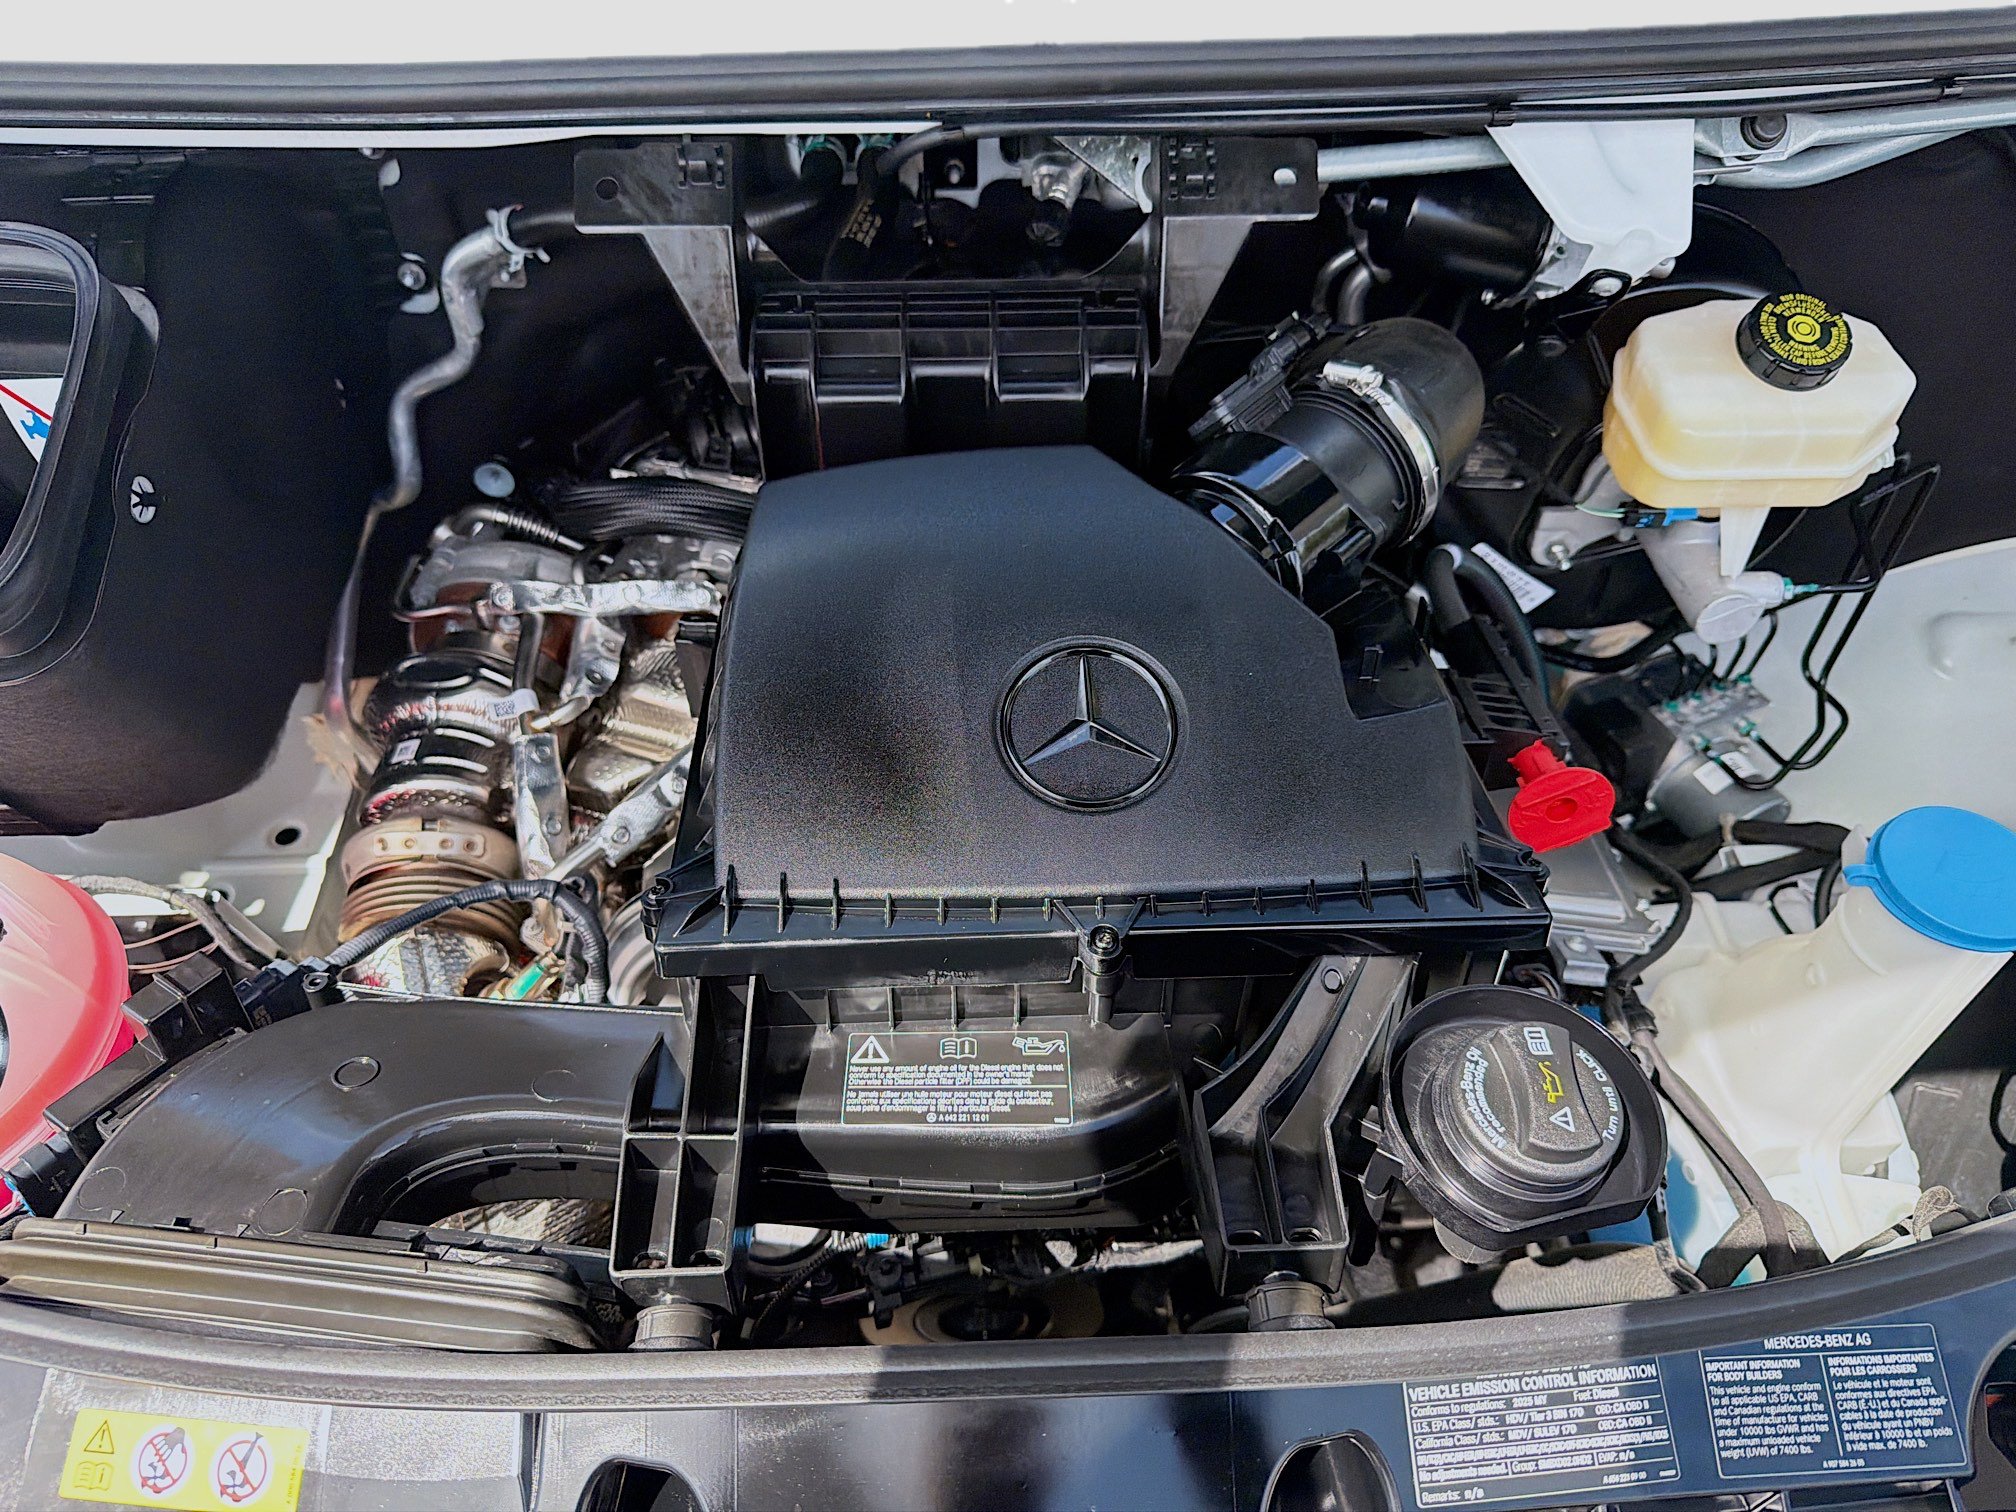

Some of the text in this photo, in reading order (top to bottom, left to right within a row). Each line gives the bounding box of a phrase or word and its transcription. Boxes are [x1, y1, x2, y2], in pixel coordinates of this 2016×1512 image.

[1576, 1049, 1607, 1082] CLICK
[1460, 1046, 1507, 1149] Mercedes-Benz Oil
[1474, 1058, 1506, 1133] recommended
[1602, 1086, 1619, 1140] Turn until
[1764, 1333, 1871, 1350] MERCEDES-BENZ AG
[1705, 1359, 1800, 1372] IMPORTANT INFORMATION
[1828, 1353, 1934, 1366] INFORMATIONS IMPORTANTES
[1706, 1370, 1782, 1382] FOR BODY BUILDERS
[1830, 1364, 1917, 1377] POUR LES CARROSSIERS
[1408, 1384, 1461, 1401] VEHICLE
[1462, 1378, 1520, 1396] EMISSION
[1521, 1372, 1578, 1392] CONTROL
[1578, 1364, 1657, 1384] INFORMATION
[1709, 1382, 1821, 1395] This vehicle and engine conform
[1411, 1404, 1450, 1417] Conforms
[1451, 1404, 1459, 1413] to
[1461, 1400, 1506, 1414] regulations:
[1513, 1398, 1533, 1408] 2025
[1534, 1395, 1547, 1405] MY
[1593, 1387, 1619, 1400] Diesel
[1711, 1392, 1818, 1406] to all applicable US EPA, CARB
[1713, 1403, 1824, 1416] and Canadian regulations at the
[1413, 1422, 1431, 1433] U.S.
[1432, 1420, 1448, 1432] EPA
[1530, 1411, 1545, 1422] Tier
[1546, 1410, 1552, 1420] 3
[1553, 1409, 1567, 1419] BIN
[1568, 1407, 1584, 1417] 170
[1626, 1401, 1643, 1412] OBD
[1715, 1413, 1828, 1426] time of manufacture for vehicles
[1717, 1423, 1829, 1437] under 10000 lbs GVWR and has
[1725, 1437, 1760, 1446] maximum
[1762, 1435, 1795, 1445] unloaded
[1796, 1434, 1821, 1443] vehicle
[1720, 1445, 1813, 1460] weight (UVW) of 7400 lbs.
[1422, 1490, 1460, 1503] Remarks:
